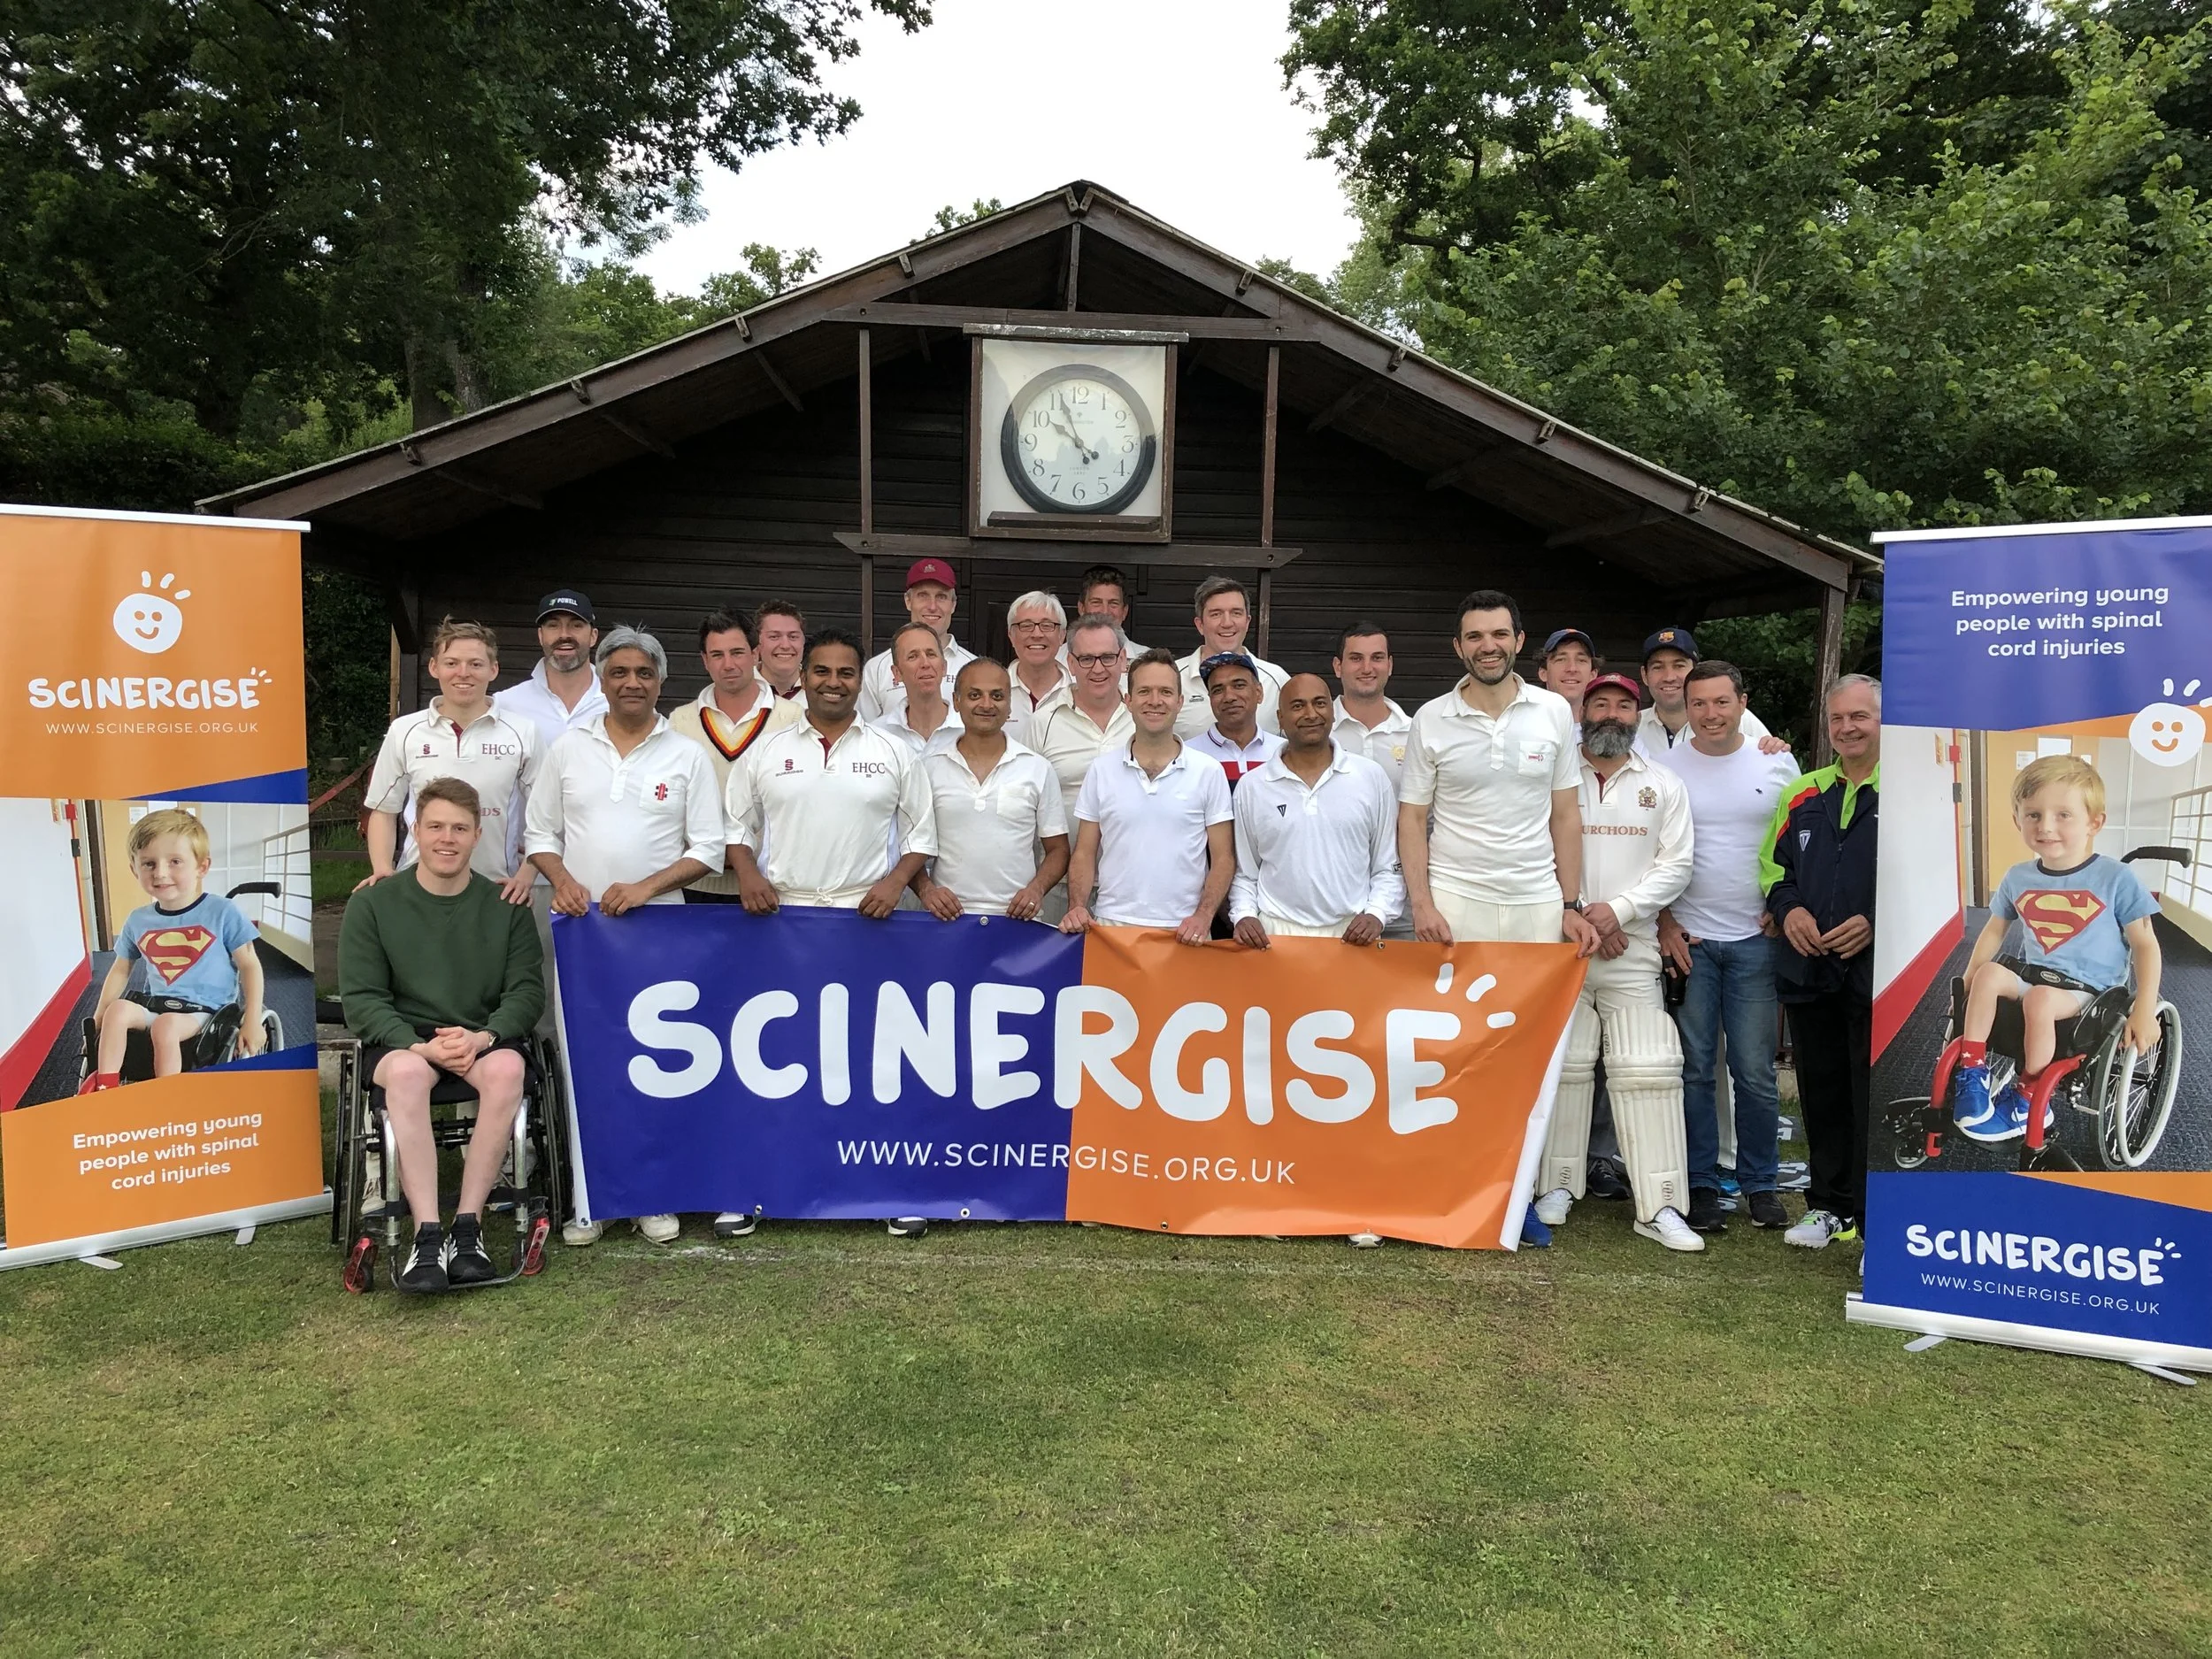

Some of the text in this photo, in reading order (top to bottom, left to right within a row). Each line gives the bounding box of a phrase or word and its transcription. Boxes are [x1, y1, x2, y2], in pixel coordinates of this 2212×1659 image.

[1050, 392, 1064, 411] 11
[1072, 386, 1089, 404] 12
[1101, 392, 1107, 411] 1
[1033, 410, 1050, 428] 10
[1115, 410, 1127, 429] 2
[1024, 433, 1038, 452] 9
[1121, 434, 1134, 454] 3
[1032, 458, 1045, 477] 8
[1112, 458, 1125, 477] 4
[1050, 473, 1062, 494] 7
[1071, 481, 1086, 501] 6
[1097, 476, 1110, 495] 5
[1951, 587, 2169, 611] Empowering young
[1956, 611, 2163, 635] people with spinal
[1987, 638, 2125, 659] cord injuries
[27, 677, 260, 710] SCINERGISE
[45, 722, 258, 734] WWW.SCINERGISE.ORG.UK
[481, 743, 516, 756] EHCC
[851, 762, 886, 774] EHCC
[1581, 825, 1648, 836] URCHODS
[626, 980, 1463, 1135] SCINERGISE
[73, 1112, 263, 1150] Empowering young
[80, 1133, 259, 1175] people with spinal
[837, 1140, 1296, 1185] WWW.SCINERGISE.ORG.UK
[111, 1161, 231, 1190] cord injuries
[1906, 1224, 2165, 1286] SCINERGISE
[1920, 1272, 2161, 1316] WWW.SCINERGISE.ORG.UK
